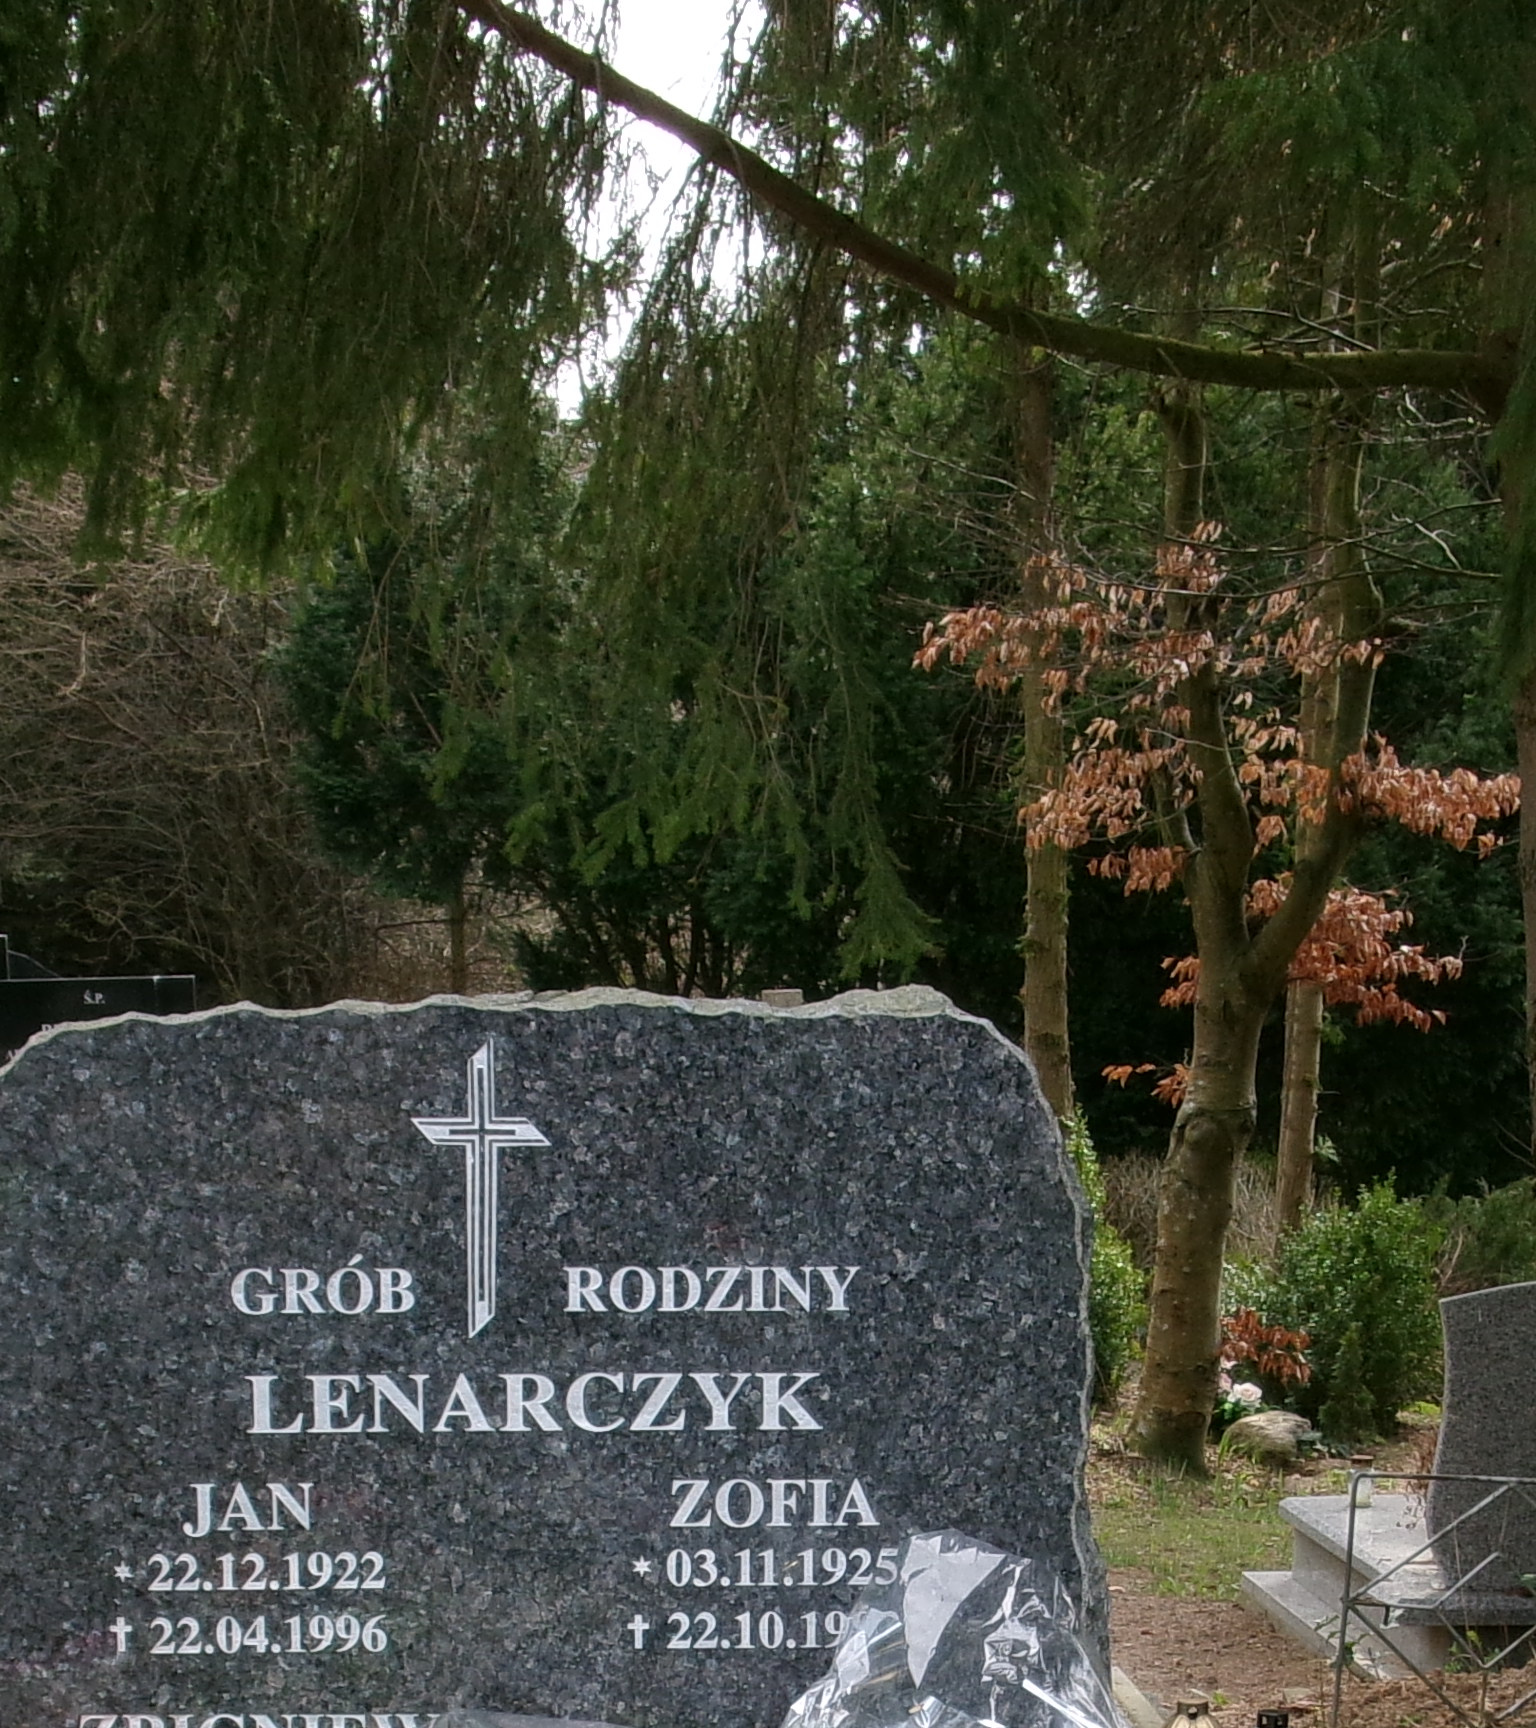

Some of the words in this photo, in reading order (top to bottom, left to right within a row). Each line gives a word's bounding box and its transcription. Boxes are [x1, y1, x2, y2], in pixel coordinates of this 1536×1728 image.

[230, 1253, 415, 1315] GRÓB
[564, 1265, 860, 1312] RODZINY
[245, 1372, 823, 1434] LENARCZYK
[182, 1482, 315, 1537] JAN
[669, 1478, 881, 1529] ZOFIA
[146, 1552, 387, 1592] 22.12.1922
[666, 1548, 901, 1588] 03.11.1925
[148, 1615, 389, 1655] 22.04.1996
[666, 1612, 860, 1651] 22.10.19
